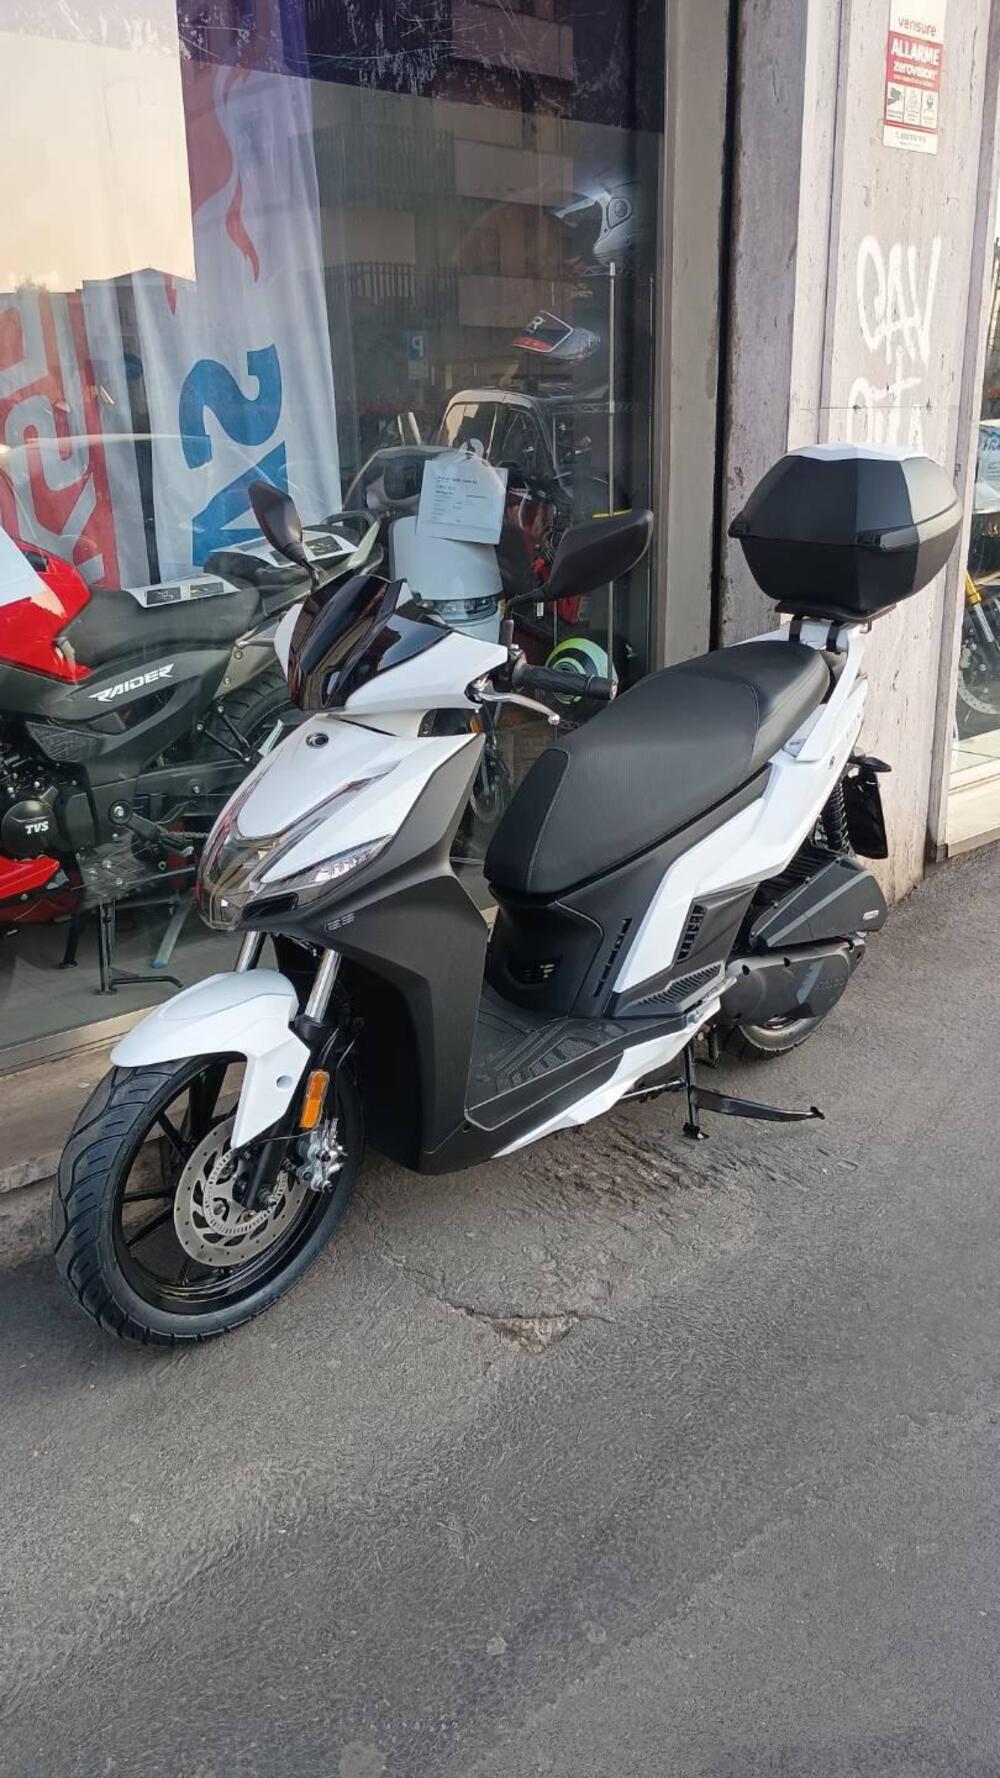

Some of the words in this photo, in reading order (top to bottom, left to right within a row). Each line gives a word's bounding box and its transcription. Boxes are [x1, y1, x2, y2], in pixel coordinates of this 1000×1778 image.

[898, 16, 937, 37] verisure
[891, 38, 941, 66] ALLARME
[87, 662, 175, 702] RAIDER
[24, 820, 49, 835] TVS
